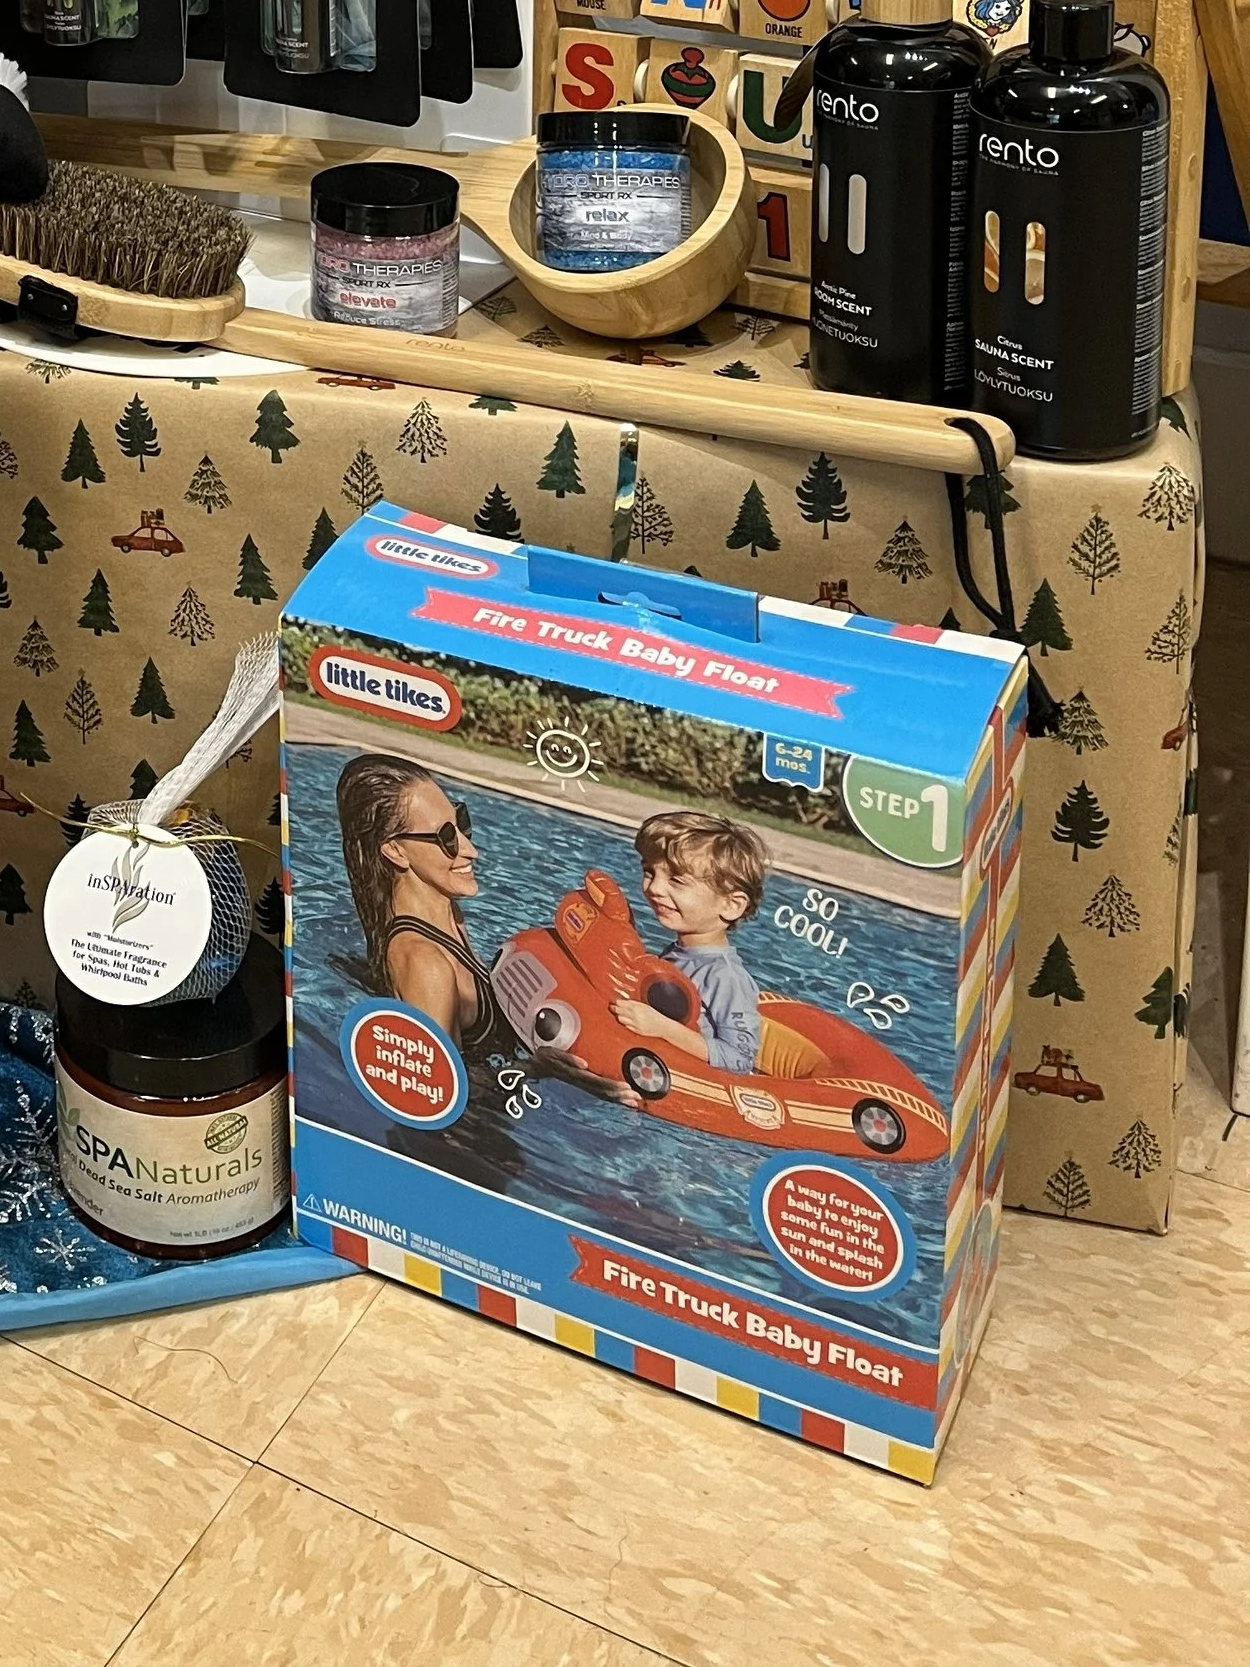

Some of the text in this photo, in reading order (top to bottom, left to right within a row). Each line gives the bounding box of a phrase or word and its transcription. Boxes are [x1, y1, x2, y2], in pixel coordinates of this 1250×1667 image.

[765, 23, 803, 39] ORANGE
[816, 89, 880, 123] rento
[978, 133, 1059, 168] rento
[585, 208, 630, 223] relax
[757, 191, 792, 262] 1
[339, 291, 398, 309] elevate
[974, 338, 1055, 371] SAUNA SCENT
[997, 335, 1023, 351] Citrus
[380, 540, 482, 573] little tikes
[473, 607, 779, 693] Fire Truck Baby Float
[326, 661, 444, 713] little tikes
[775, 742, 813, 762] 6-24
[775, 757, 811, 774] mos.
[859, 786, 920, 819] STEP
[921, 784, 948, 852] 1
[87, 873, 174, 905] inSPAration
[802, 888, 840, 922] SO
[774, 905, 849, 959] COOL!
[71, 938, 168, 969] The Ultimate Fragrance
[372, 1024, 434, 1064] Simply
[376, 1045, 433, 1078] inflate
[365, 1064, 444, 1104] and play!
[79, 1159, 261, 1205] Dead Sea Salt Aromatherapy
[784, 1179, 885, 1222] A way for your
[322, 1197, 408, 1245] WARNING!
[603, 1259, 904, 1387] Fire Truck Baby Float
